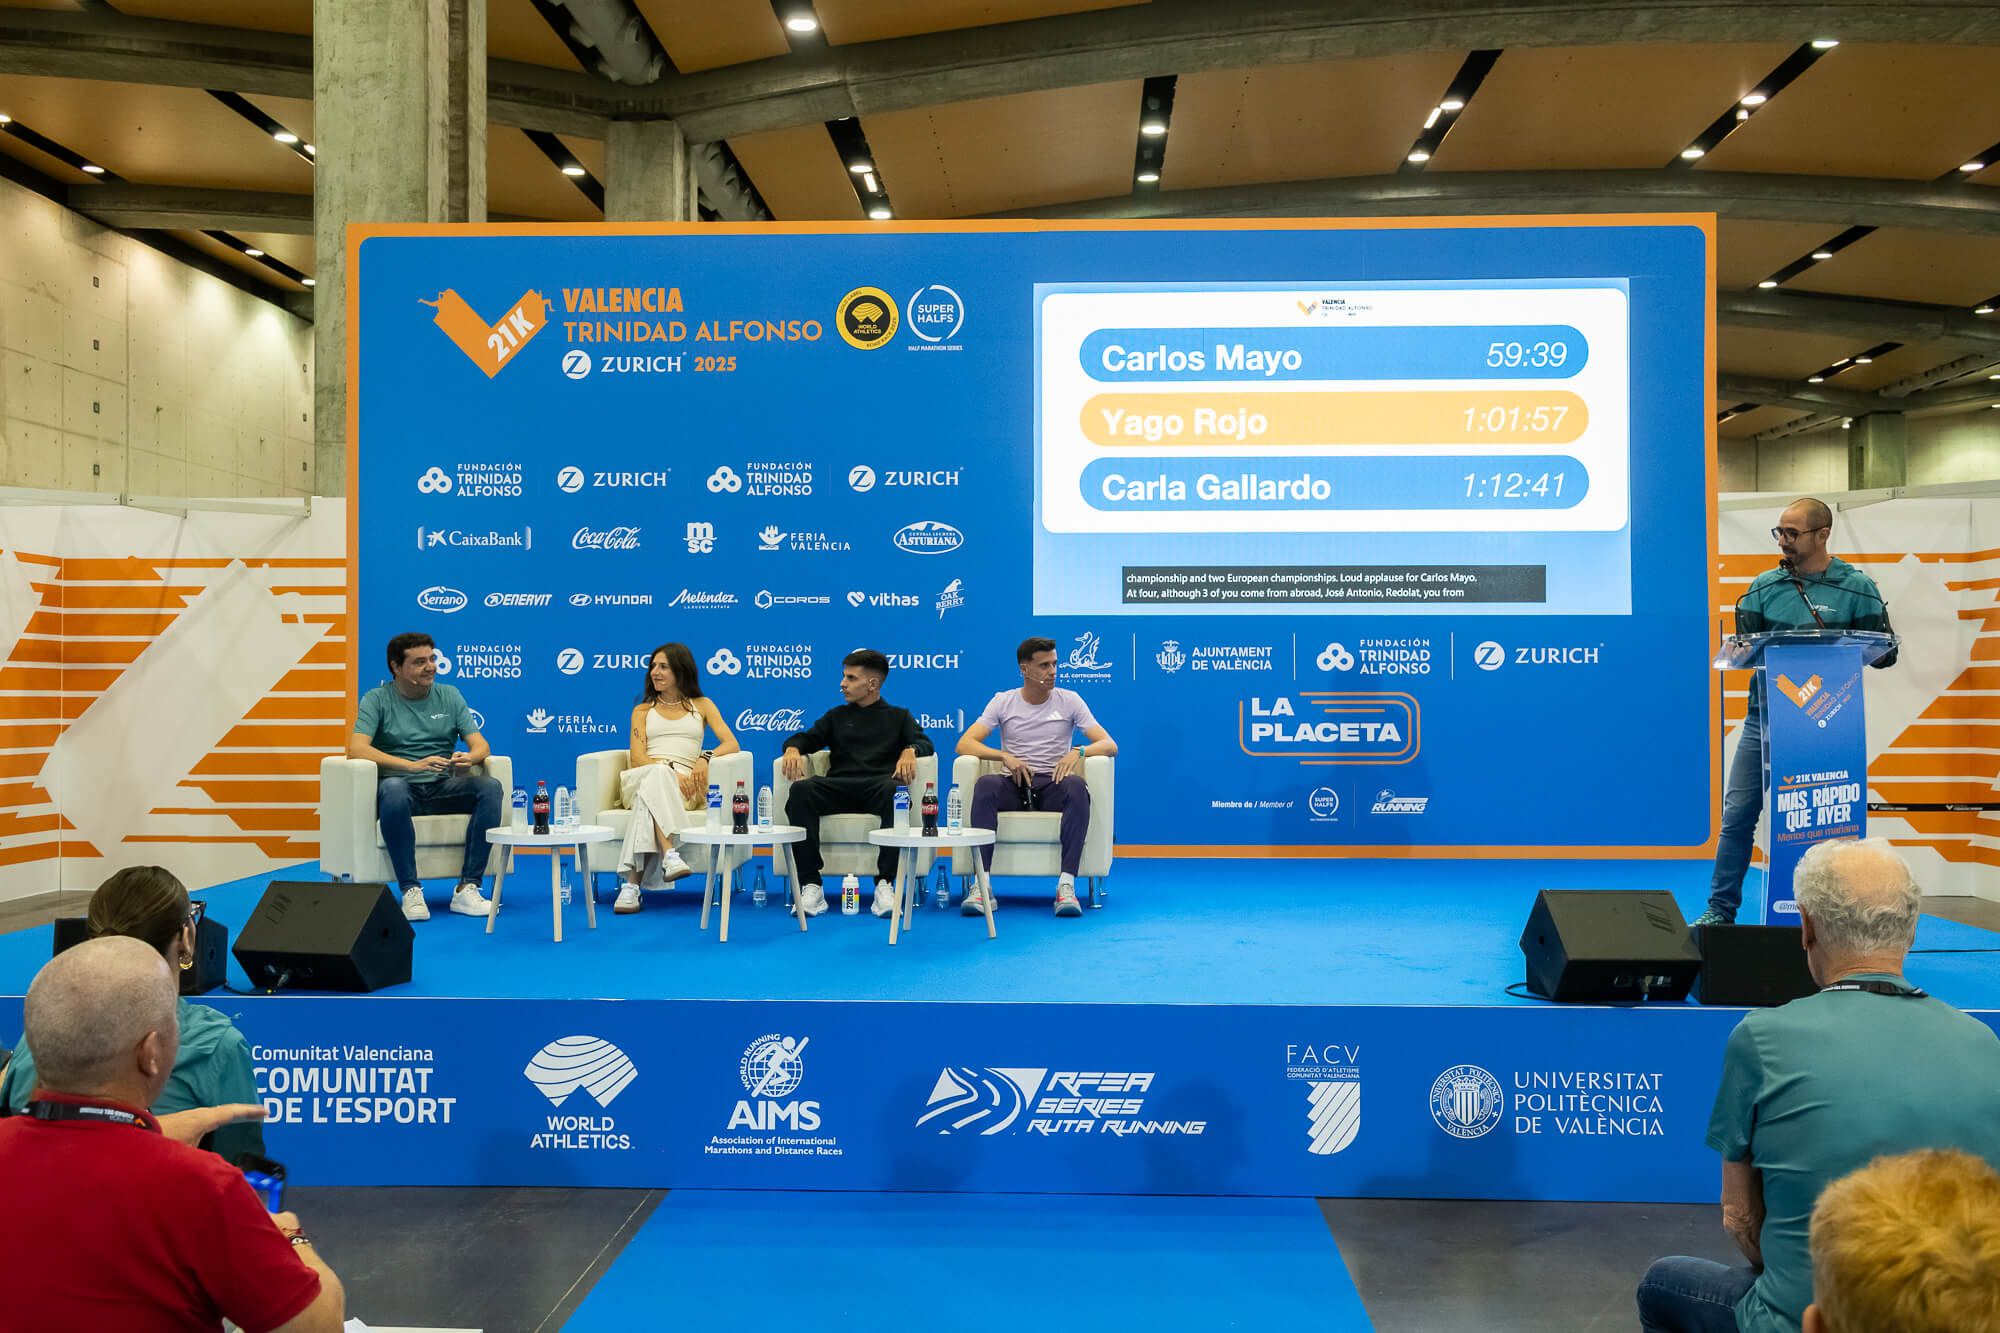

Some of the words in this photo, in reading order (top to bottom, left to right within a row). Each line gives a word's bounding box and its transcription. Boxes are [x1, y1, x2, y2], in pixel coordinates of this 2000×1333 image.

[563, 288, 683, 312] VALENCIA
[919, 305, 953, 313] SUPER
[918, 314, 953, 322] HALFS
[488, 305, 536, 362] 21K
[564, 322, 686, 341] TRINIDAD
[696, 321, 822, 341] ALFONSO
[1102, 344, 1205, 371] Carlos
[1215, 344, 1302, 375] Mayo
[1486, 341, 1568, 369] 59:39
[600, 356, 682, 373] ZURICH
[694, 356, 737, 372] 2025
[1102, 409, 1184, 441] Yago
[1194, 408, 1268, 440] Rojo
[1463, 406, 1568, 432] 1:01:57
[458, 462, 521, 470] FUNDACIÓN
[748, 461, 811, 469] FUNDACIÓN
[457, 474, 521, 484] TRINIDAD
[594, 473, 665, 486] ZURICH
[747, 473, 811, 483] TRINIDAD
[886, 472, 958, 485] ZURICH
[1463, 472, 1566, 498] 1:12:41
[458, 486, 521, 496] ALFONSO
[747, 485, 811, 495] ALFONSO
[1102, 474, 1186, 501] Carla
[1196, 473, 1331, 502] Gallardo
[450, 532, 521, 545] CaixaBank
[573, 527, 640, 549] Coca-Cola
[899, 532, 958, 546] ASTURIANA
[1127, 573, 1188, 584] championship
[1190, 573, 1206, 582] and
[1208, 574, 1225, 582] two
[1228, 573, 1268, 584] European
[1270, 573, 1338, 584] championships.
[1340, 573, 1362, 582] Loud
[1364, 573, 1404, 584] applause
[1406, 573, 1419, 582] for
[1421, 573, 1448, 582] Carlos
[1450, 573, 1477, 584] Mayo.
[423, 593, 463, 605] Serrano
[595, 596, 651, 604] HYUNDAI
[870, 593, 918, 605] vithas
[941, 592, 958, 600] OAK
[1127, 589, 1137, 598] At
[1139, 588, 1159, 598] four,
[1161, 588, 1201, 600] although
[1203, 589, 1208, 598] 3
[1210, 588, 1220, 598] of
[1222, 590, 1238, 600] you
[1241, 590, 1264, 598] come
[1267, 588, 1288, 598] from
[1290, 588, 1323, 598] abroad,
[1325, 588, 1344, 598] José
[1346, 588, 1384, 598] Antonio,
[1386, 588, 1421, 598] Redolat,
[1424, 590, 1440, 600] you
[1443, 588, 1464, 597] from
[936, 597, 964, 608] BERRY
[458, 643, 520, 652] FUNDACIÓN
[747, 643, 810, 652] FUNDACIÓN
[1361, 638, 1429, 646] FUNDACIÓN
[1193, 647, 1272, 656] AJUNTAMENT
[1360, 650, 1430, 660] TRINIDAD
[1516, 648, 1597, 663] ZURICH
[457, 655, 521, 665] TRINIDAD
[592, 654, 652, 668] ZURIC
[747, 656, 811, 665] TRINIDAD
[886, 654, 959, 669] ZURICH
[1192, 660, 1207, 670] DE
[1211, 658, 1272, 670] VALÈNCIA
[458, 668, 521, 677] ALFONSO
[747, 668, 811, 677] ALFONSO
[1360, 663, 1430, 674] ALFONSO
[1798, 681, 1816, 702] 21K
[1252, 698, 1294, 715] LA
[736, 709, 803, 730] Coca-Cola
[916, 714, 954, 729] Bank
[1252, 723, 1400, 742] PLACETA
[1796, 774, 1810, 783] 21K
[1812, 770, 1848, 782] VALENCIA
[1212, 800, 1242, 808] Miembro
[1244, 800, 1252, 808] de
[1260, 800, 1286, 808] Member
[1778, 788, 1808, 812] MÁS
[1812, 783, 1860, 808] RÁPIDO
[1372, 803, 1425, 811] RUNNING
[1786, 808, 1812, 832] QUE
[1817, 804, 1851, 825] AYER
[1778, 832, 1806, 842] Menos
[1808, 830, 1822, 839] que
[1825, 824, 1860, 835] mañana
[744, 1034, 780, 1057] RUNNING
[253, 1046, 338, 1060] Comunitat
[344, 1046, 433, 1060] Valenciana
[1287, 1045, 1359, 1064] FACV
[253, 1067, 433, 1093] COMUNITAT
[740, 1058, 751, 1090] WORLD
[1514, 1072, 1663, 1090] UNIVERSITAT
[1044, 1071, 1154, 1096] RFEA
[1036, 1098, 1143, 1118] SERIES
[1515, 1091, 1663, 1112] POLITÈCNICA
[264, 1098, 303, 1123] DE
[312, 1097, 456, 1124] L'ESPORT
[727, 1101, 820, 1130] AIMS
[548, 1117, 614, 1130] WORLD
[1027, 1120, 1091, 1136] RUTA
[1101, 1120, 1206, 1136] RUNNING
[1446, 1123, 1489, 1136] VALENCIA
[1516, 1116, 1542, 1134] DE
[1556, 1114, 1664, 1135] VALÈNCIA
[531, 1134, 629, 1149] ATHLETICS
[712, 1136, 763, 1145] Association
[766, 1136, 776, 1145] of
[778, 1136, 836, 1145] International
[705, 1146, 752, 1154] Marathons
[755, 1146, 771, 1154] and
[774, 1146, 814, 1155] Distance
[816, 1147, 843, 1155] Races
